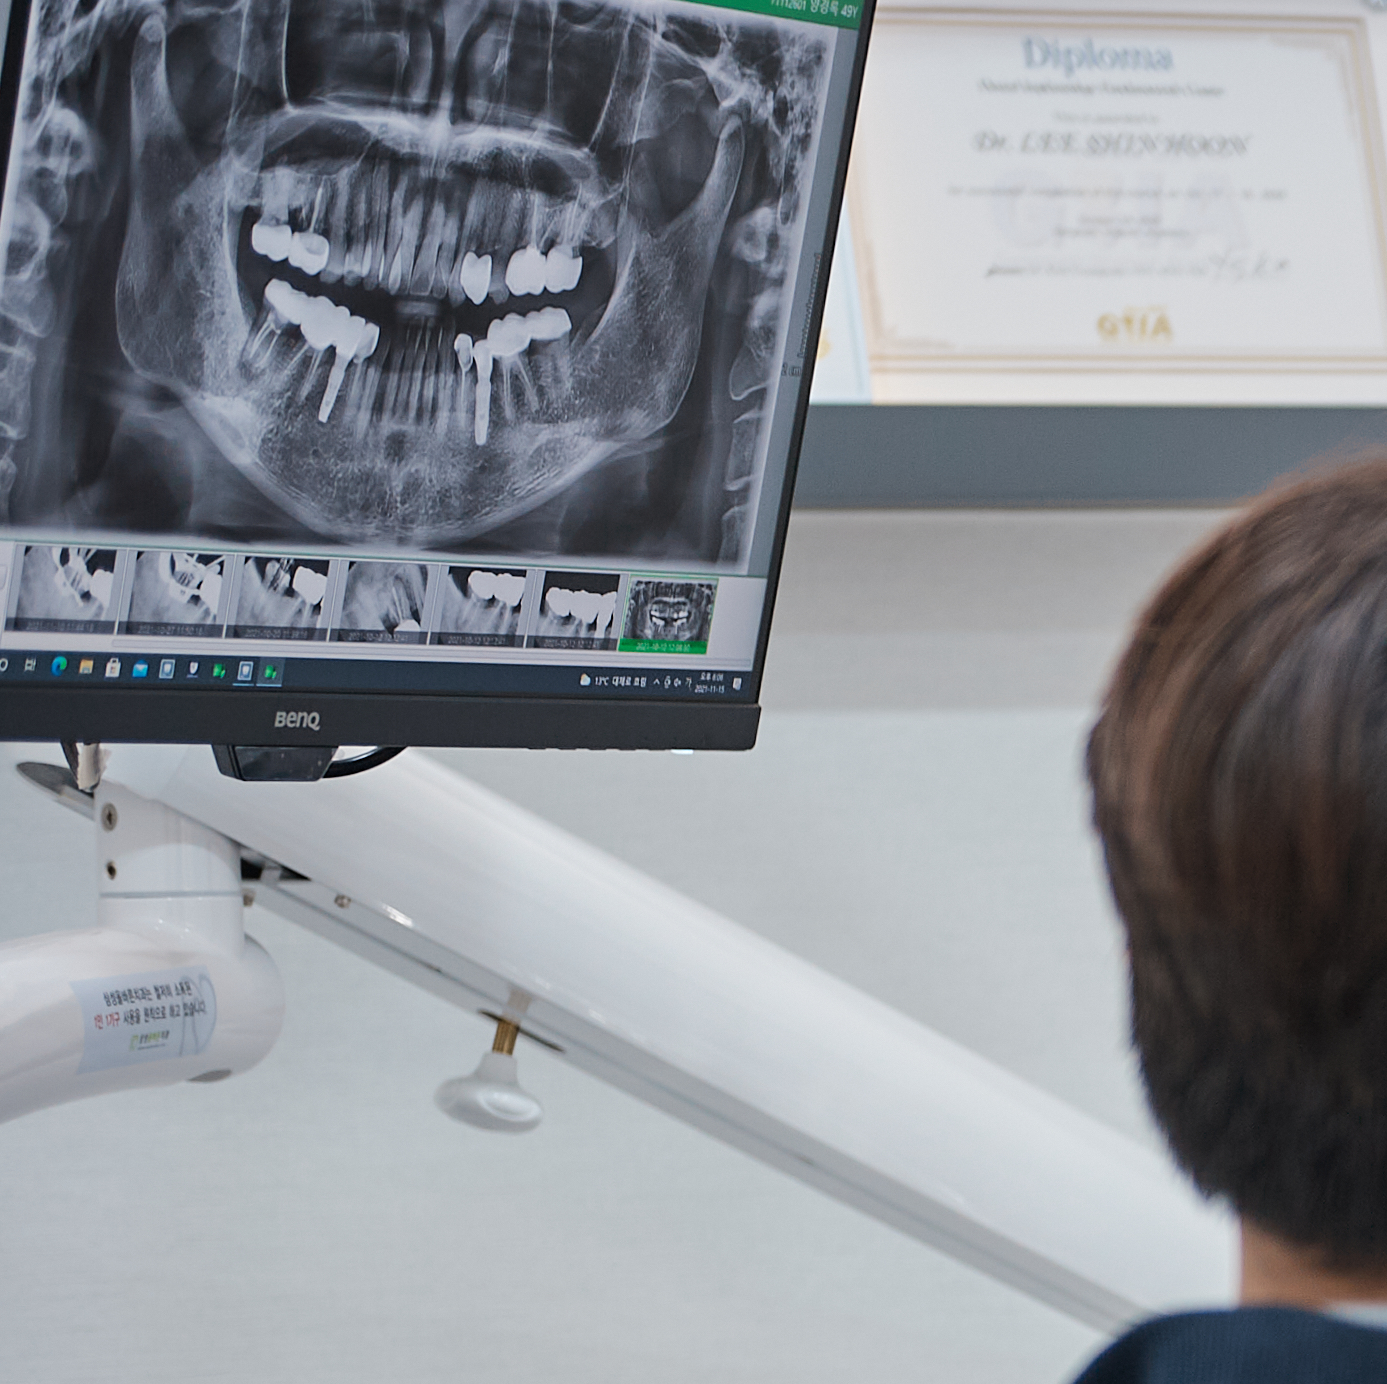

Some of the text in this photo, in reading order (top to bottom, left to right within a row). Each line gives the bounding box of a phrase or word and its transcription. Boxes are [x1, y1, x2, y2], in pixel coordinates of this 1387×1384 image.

[840, 4, 859, 19] 49Y
[1021, 35, 1175, 78] Diploma
[274, 711, 321, 731] BenQ
